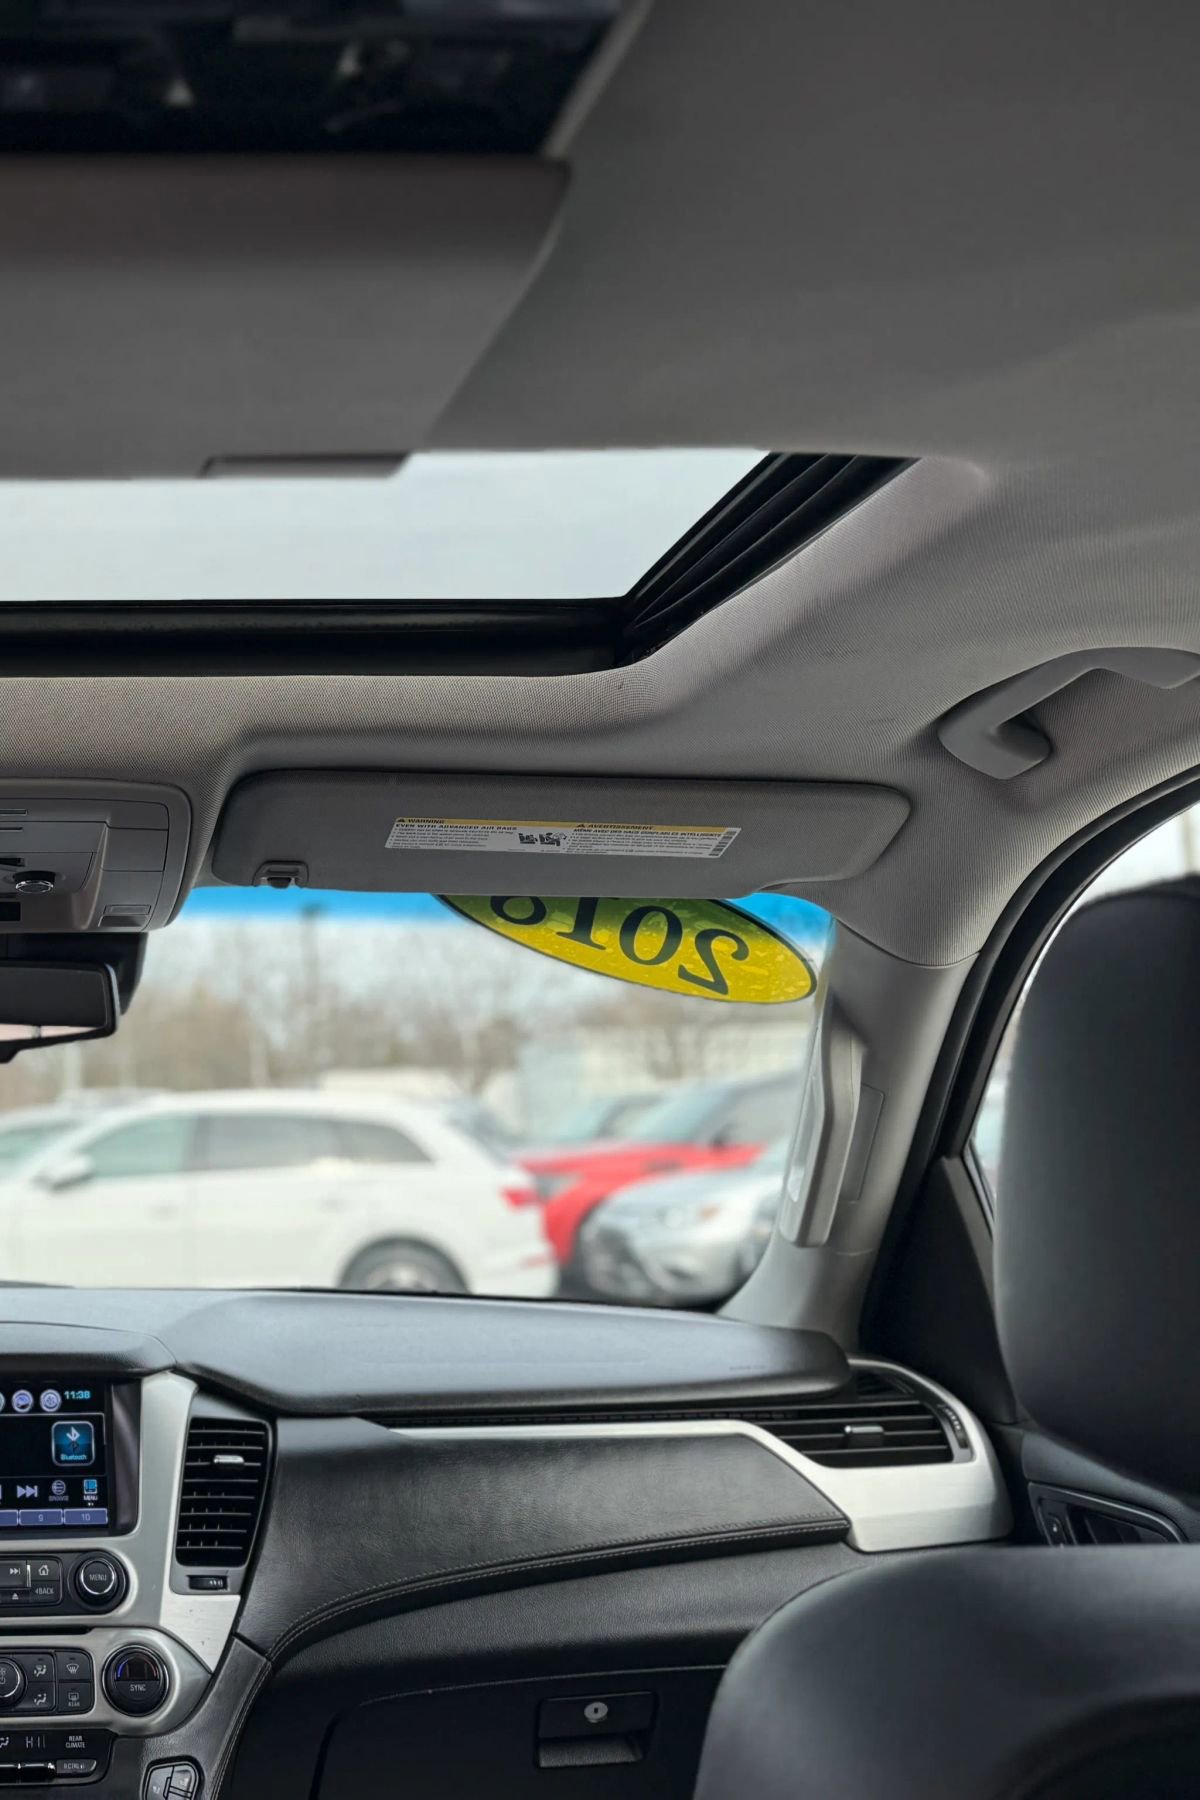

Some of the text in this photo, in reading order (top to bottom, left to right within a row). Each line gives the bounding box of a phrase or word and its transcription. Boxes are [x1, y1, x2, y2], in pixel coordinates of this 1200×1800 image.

[89, 1574, 107, 1582] MENU
[38, 1587, 54, 1595] BACK
[130, 1683, 146, 1692] SYNC
